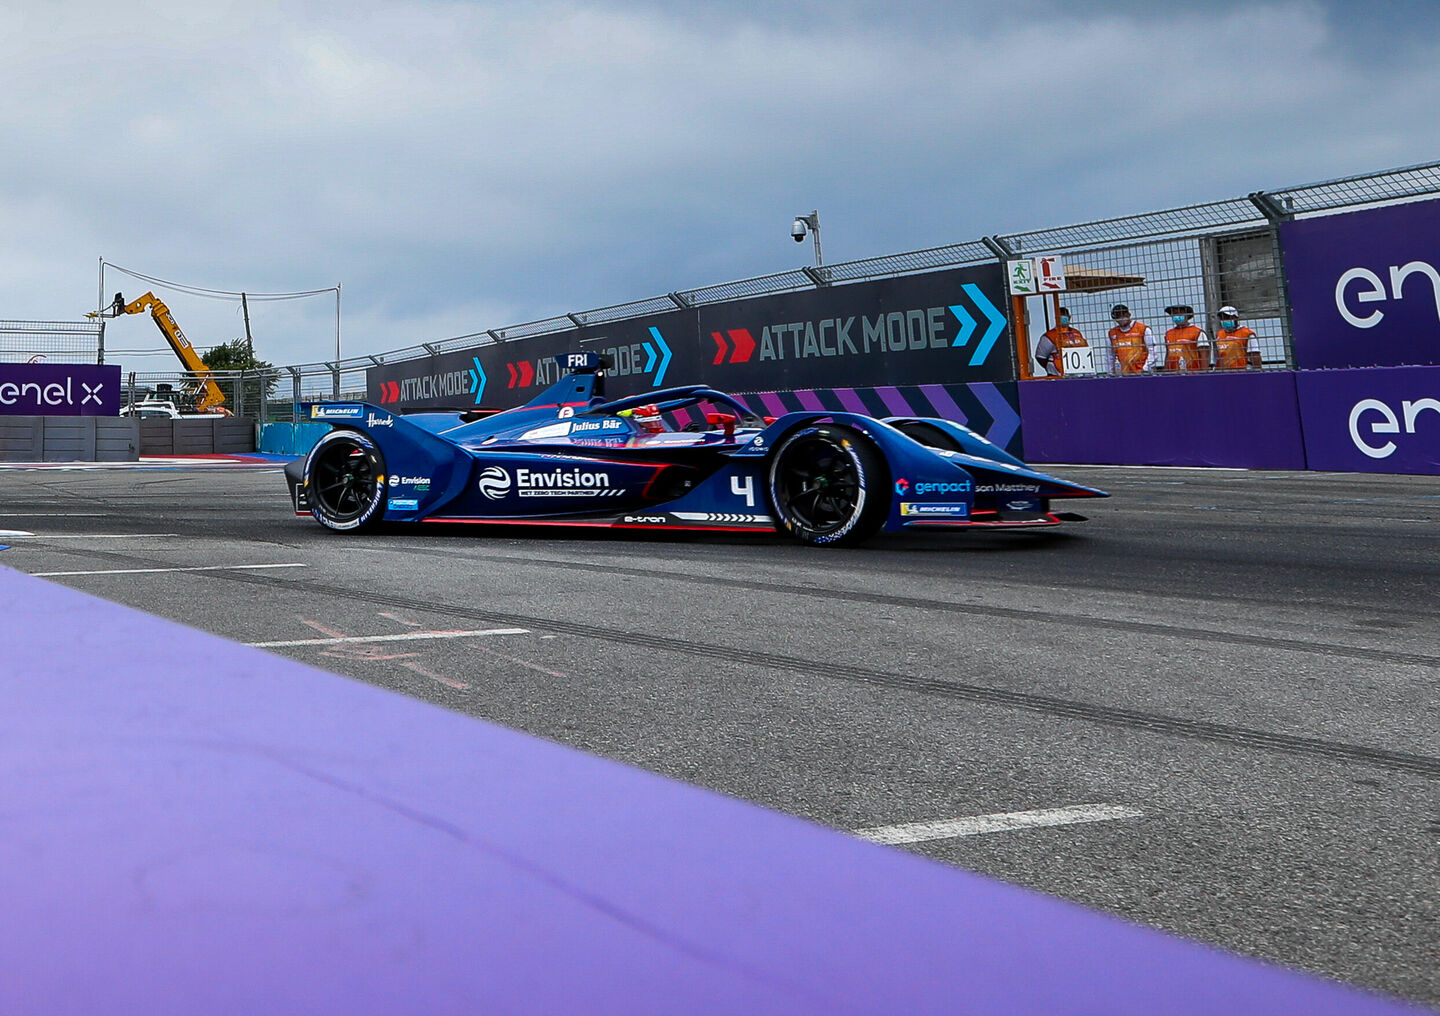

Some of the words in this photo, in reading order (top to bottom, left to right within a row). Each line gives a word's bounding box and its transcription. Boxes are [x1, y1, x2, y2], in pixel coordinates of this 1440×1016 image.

[759, 316, 858, 361] ATTACK
[862, 306, 949, 354] MODE
[567, 353, 588, 368] FRI
[601, 343, 643, 378] ODE
[1063, 350, 1094, 370] 10.1
[400, 373, 439, 402] ATTACK
[439, 370, 469, 399] MODE
[571, 421, 601, 434] Julius
[602, 420, 622, 430] Bär
[401, 476, 431, 485] Envision
[516, 468, 609, 487] Envision
[730, 475, 755, 507] 4
[915, 480, 971, 495] genpact
